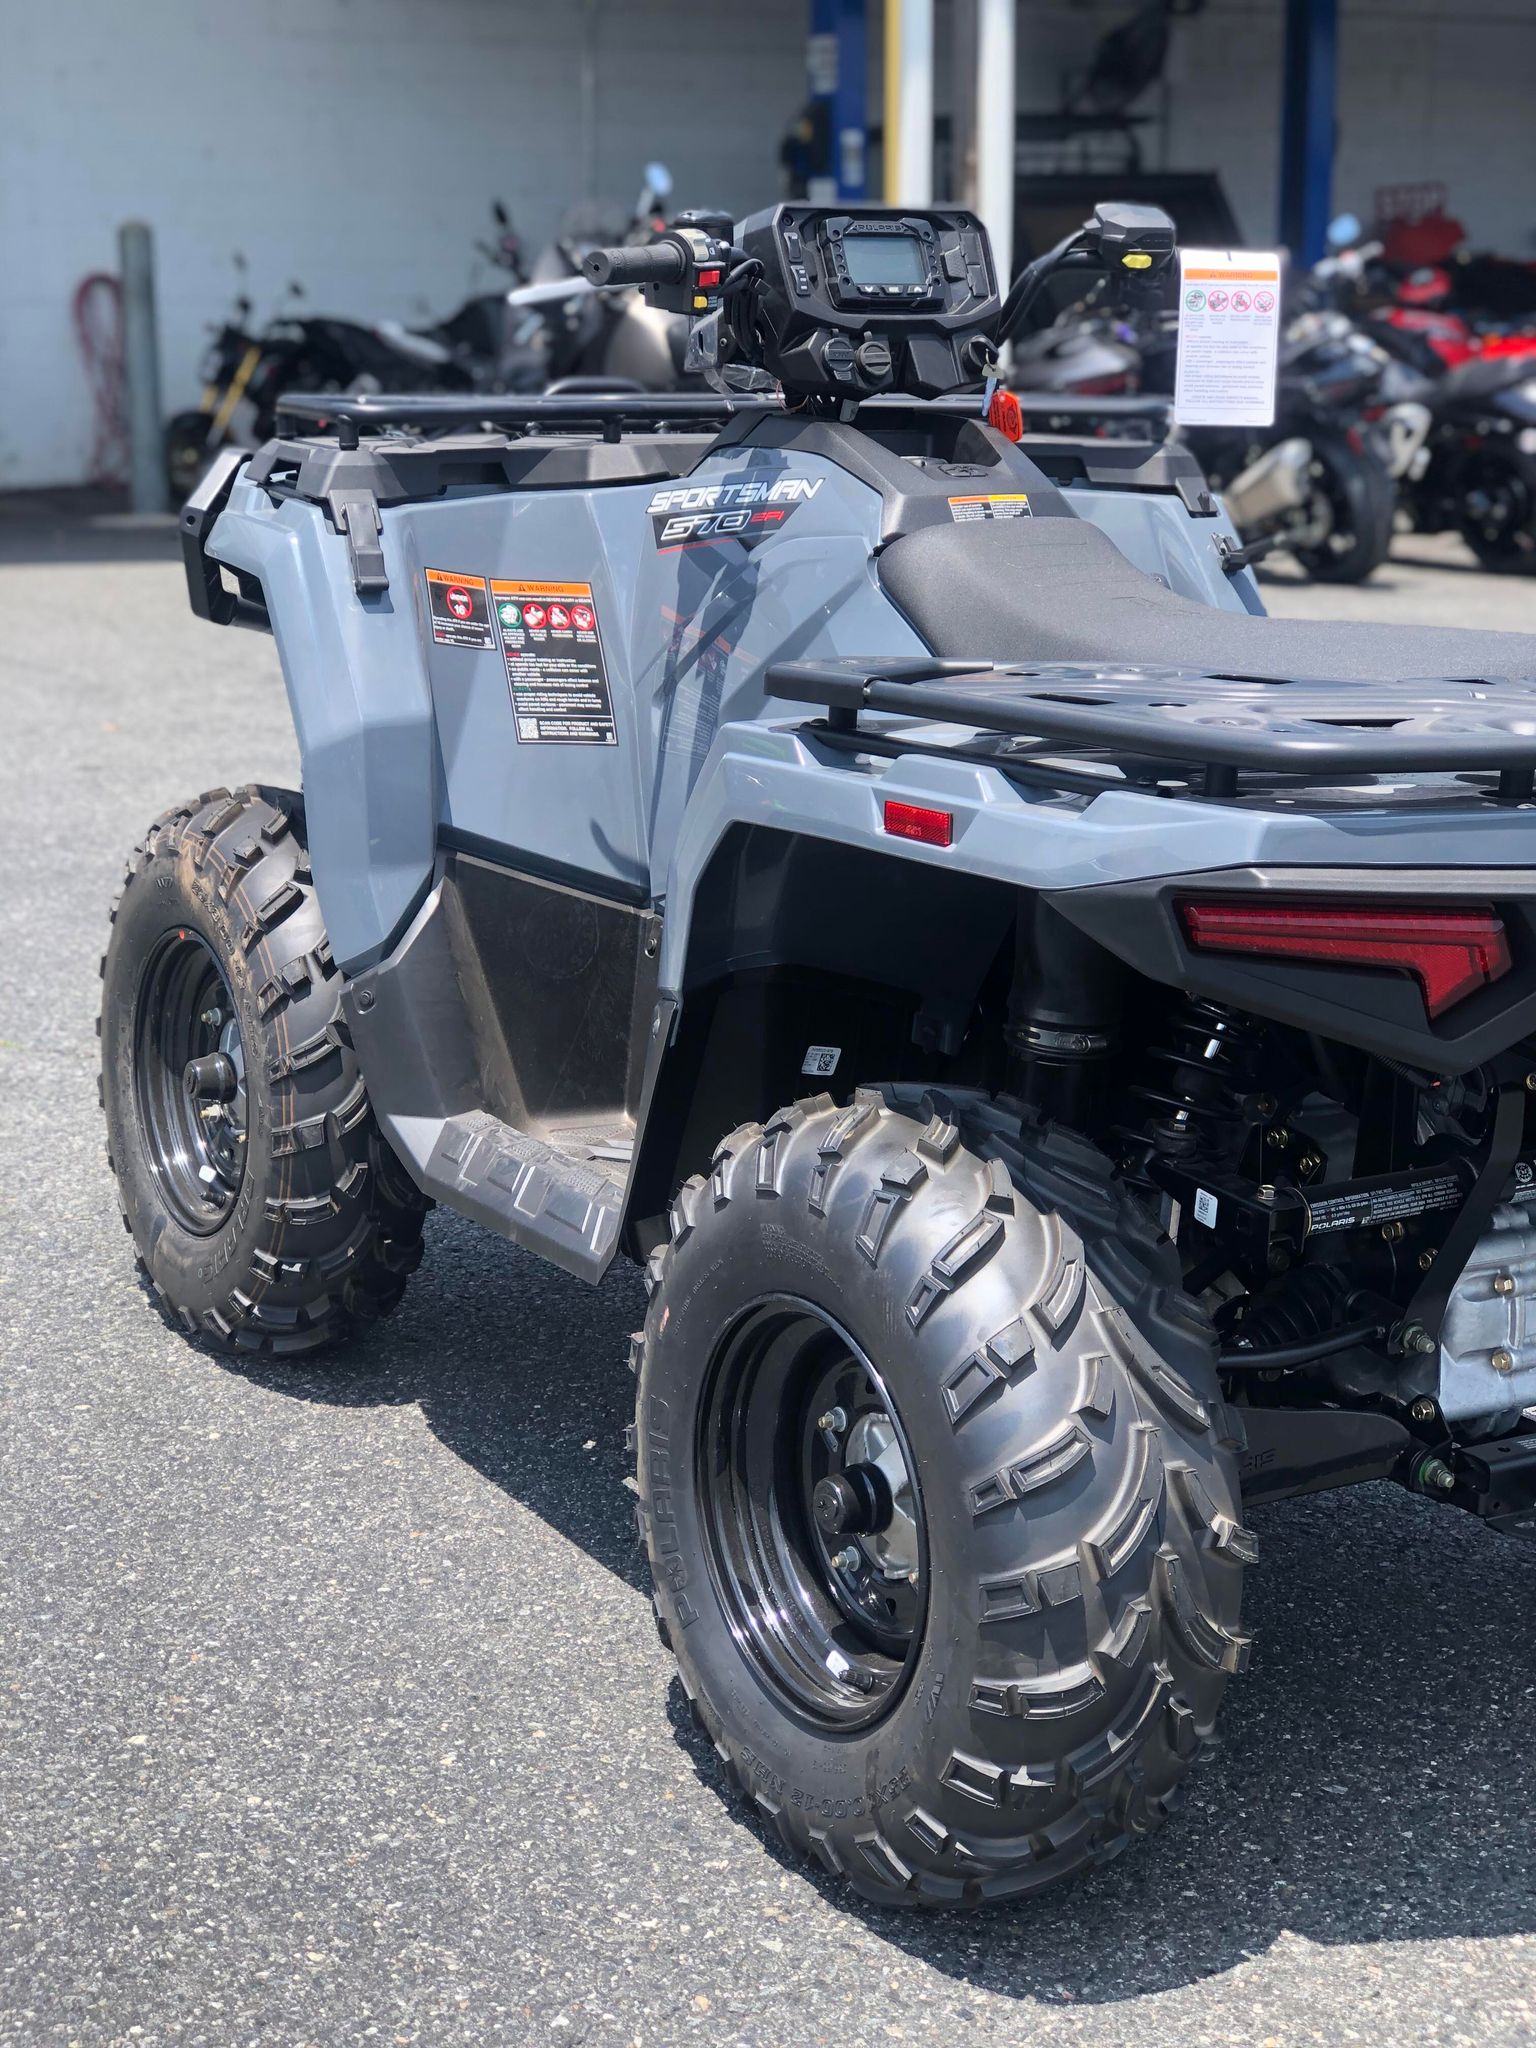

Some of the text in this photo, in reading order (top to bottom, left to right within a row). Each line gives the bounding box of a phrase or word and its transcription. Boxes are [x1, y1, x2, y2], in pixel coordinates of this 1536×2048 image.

[1382, 190, 1445, 218] STOP
[645, 477, 826, 514] SPORTSMAN
[660, 510, 785, 540] 570 EFI
[444, 574, 474, 586] WARNING
[527, 584, 564, 593] WARNING
[450, 592, 468, 602] UNDER
[454, 604, 466, 616] 16
[1310, 1216, 1356, 1231] POLARIS
[649, 1393, 700, 1630] POLARIS
[740, 1746, 788, 1795] NHS
